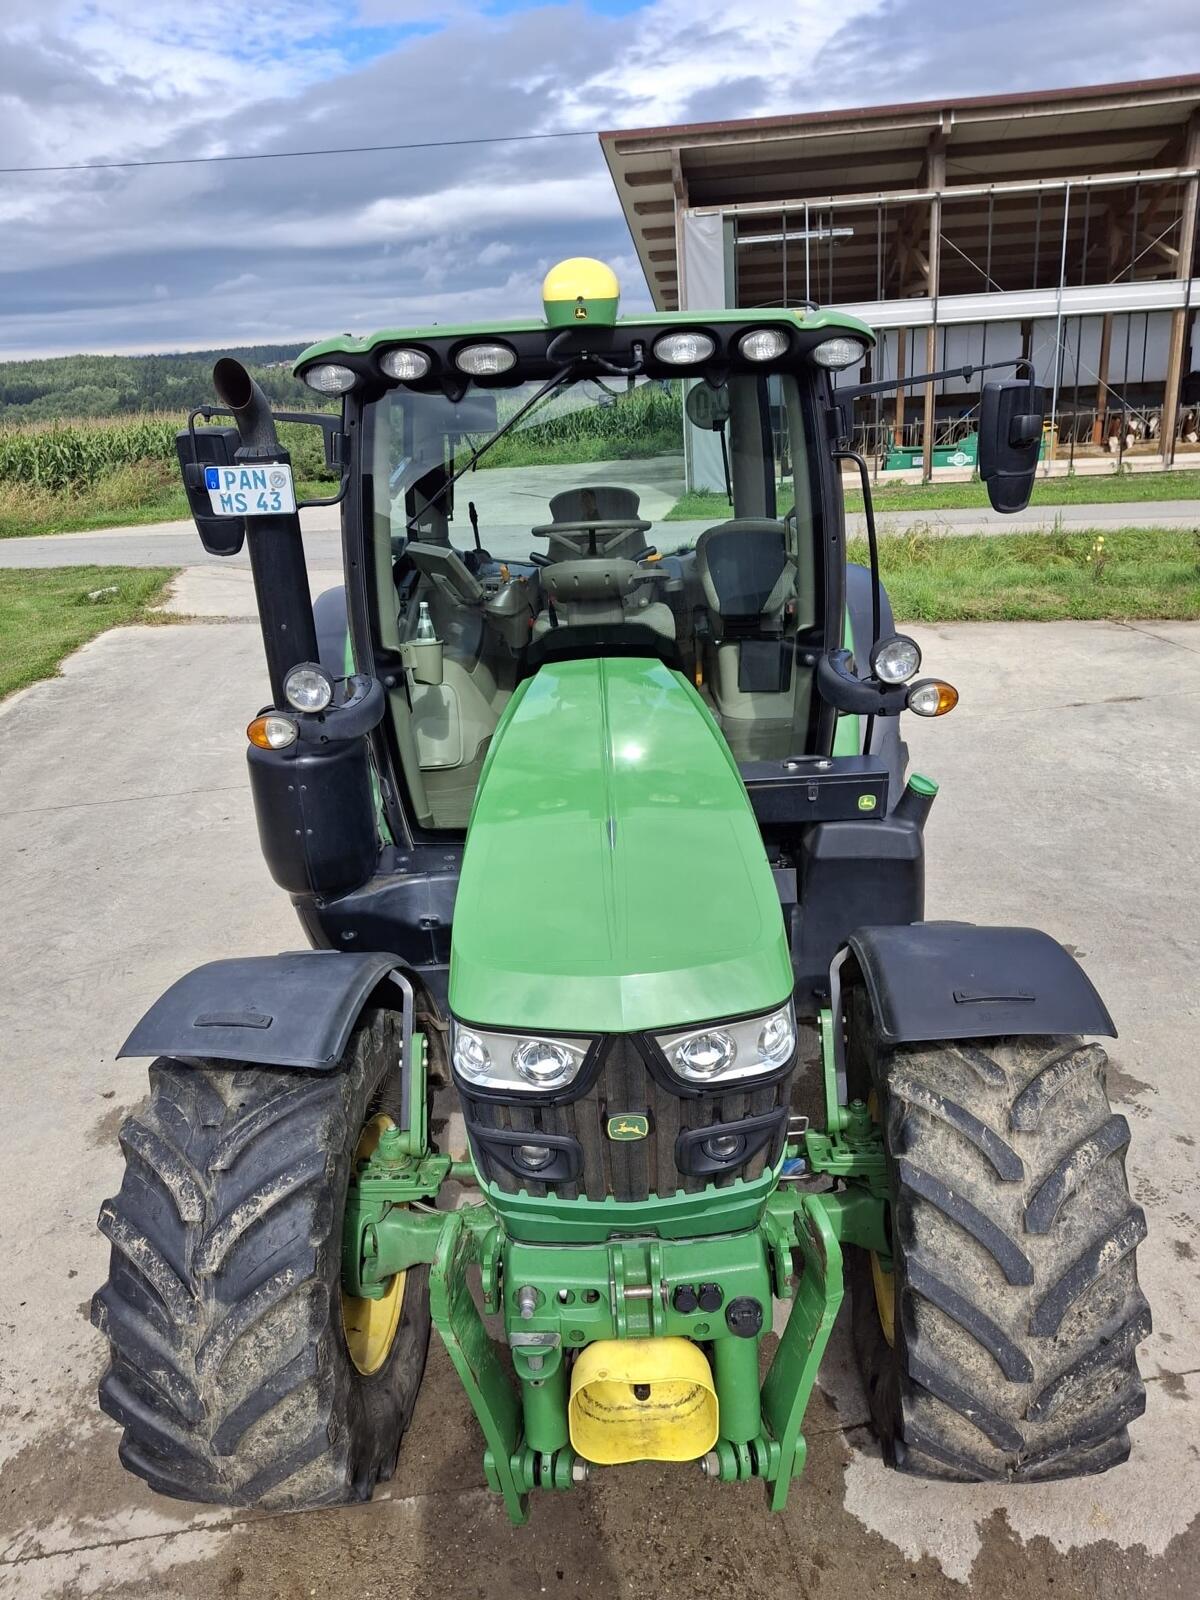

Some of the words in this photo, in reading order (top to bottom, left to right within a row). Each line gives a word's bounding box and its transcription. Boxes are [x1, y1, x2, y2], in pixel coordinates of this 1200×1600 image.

[211, 481, 216, 489] D
[224, 470, 267, 490] PAN
[220, 493, 248, 513] MS
[256, 491, 282, 512] 43
